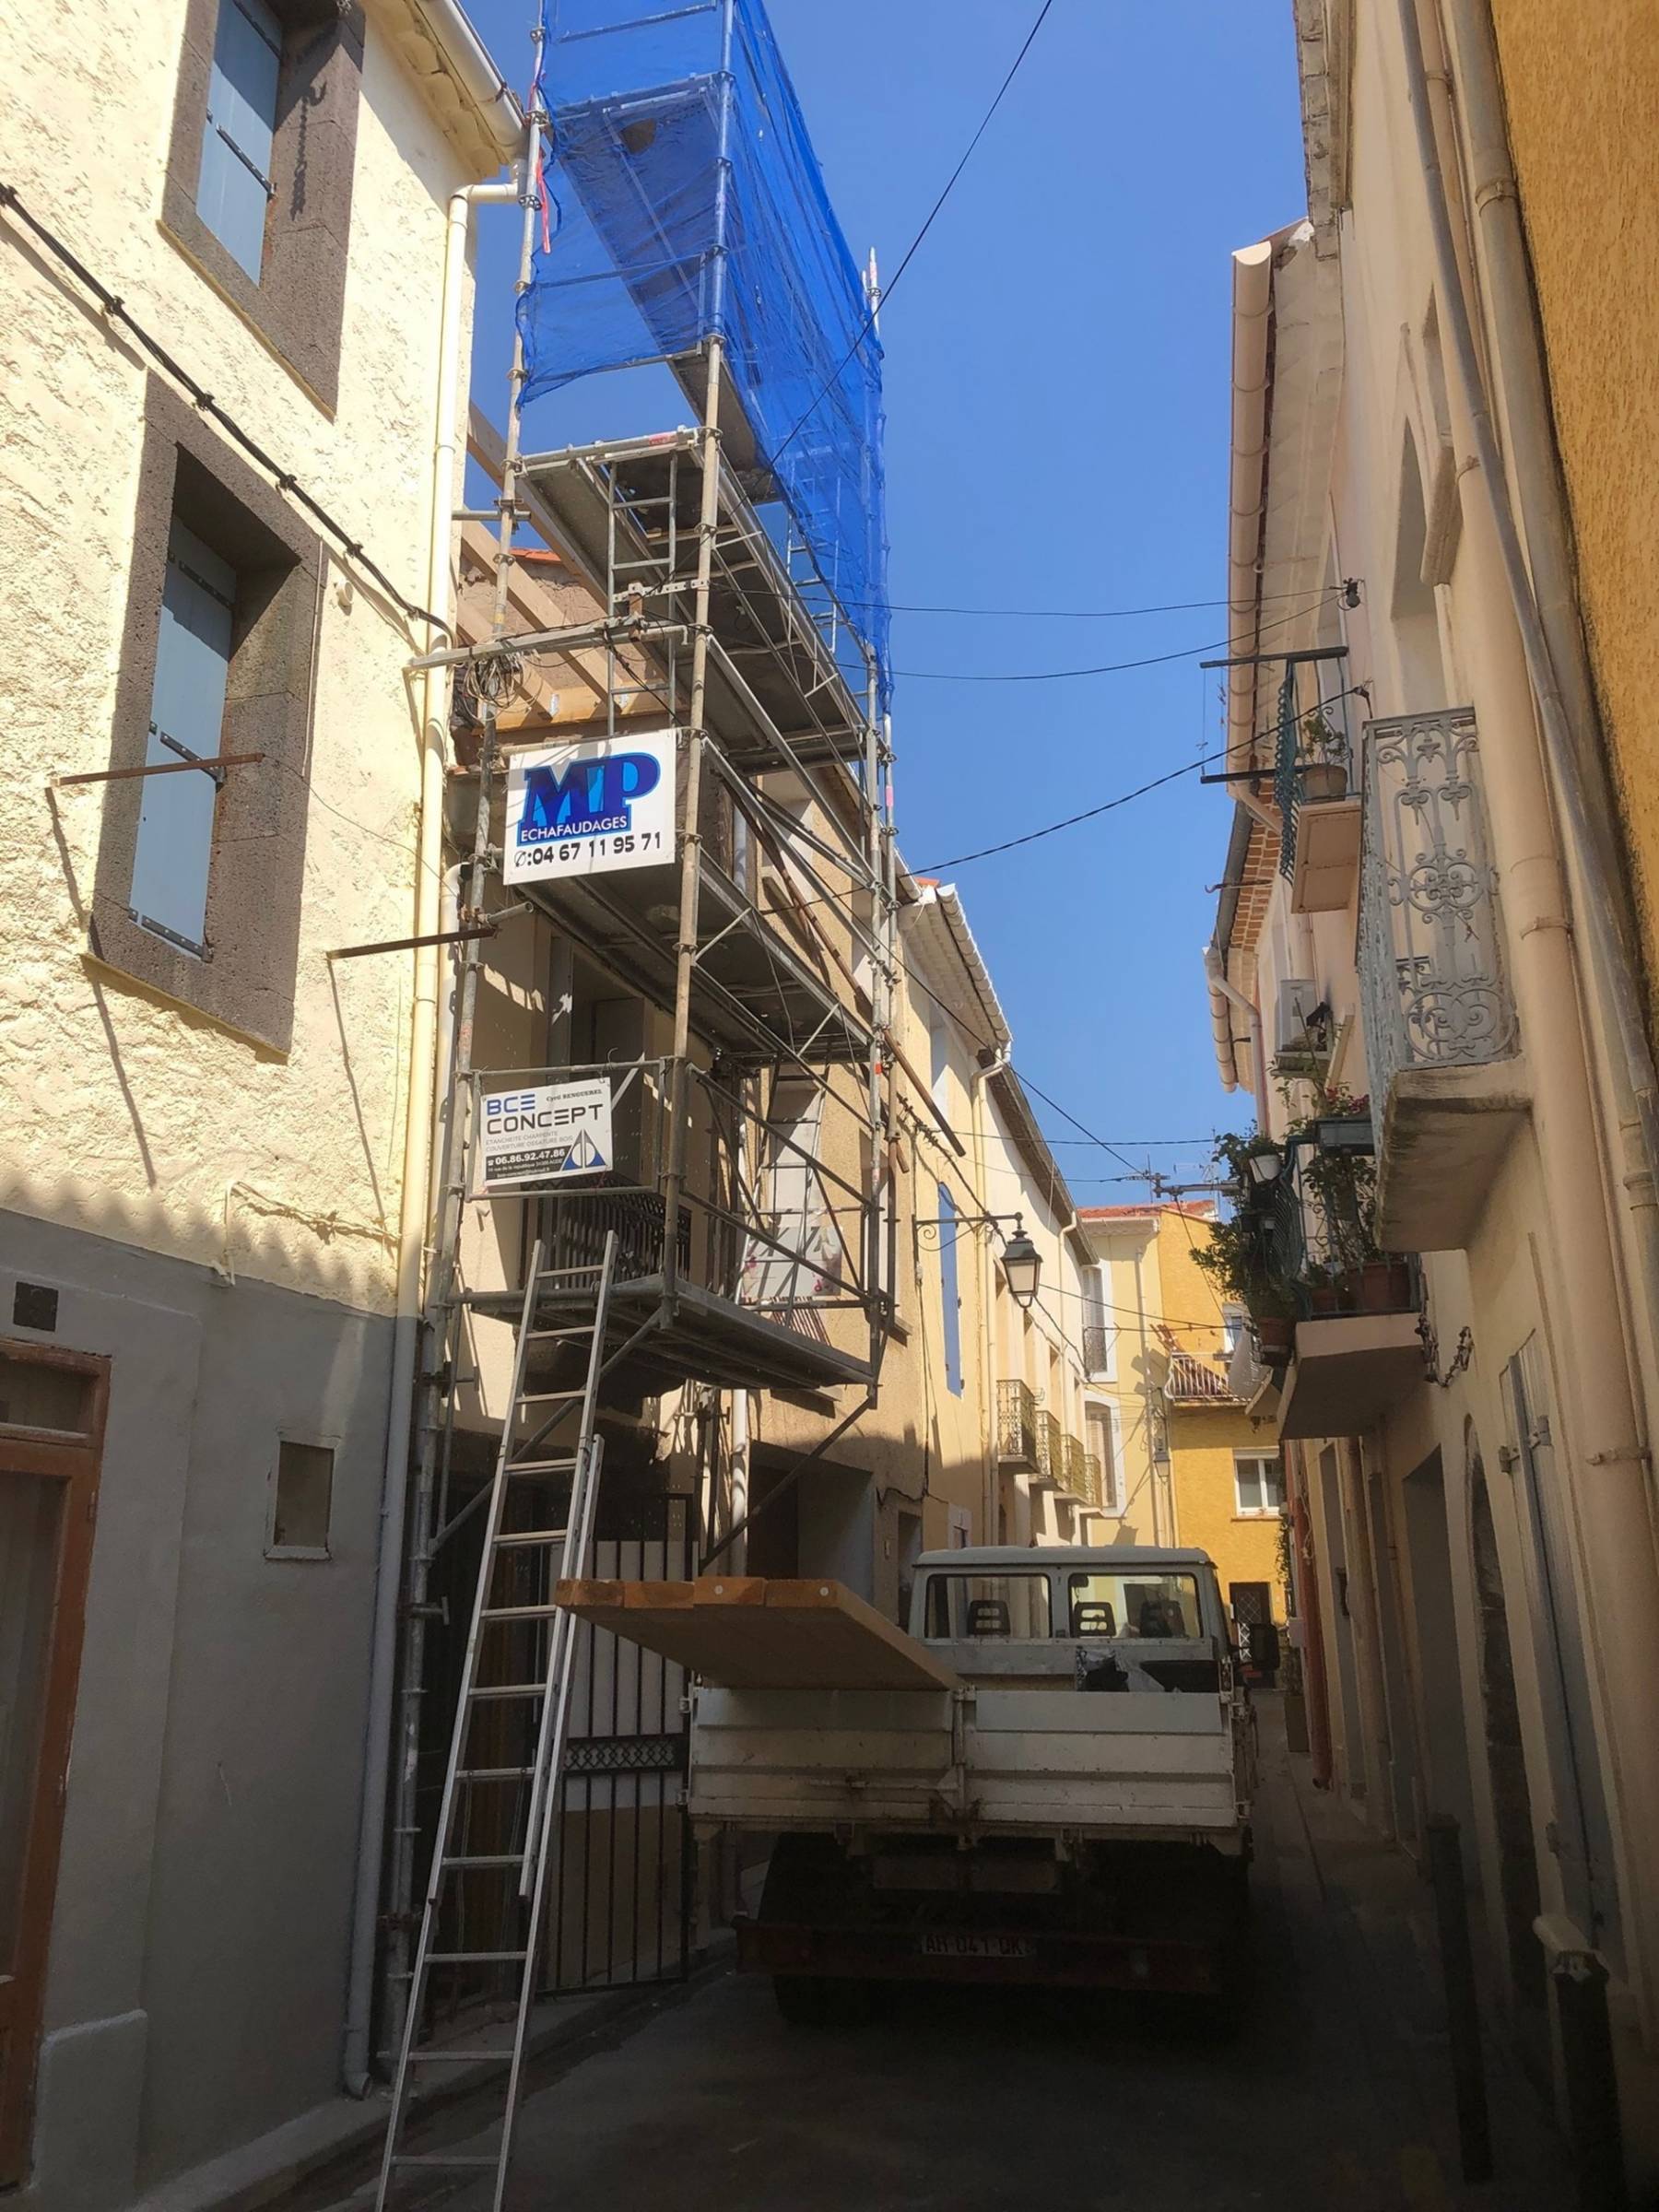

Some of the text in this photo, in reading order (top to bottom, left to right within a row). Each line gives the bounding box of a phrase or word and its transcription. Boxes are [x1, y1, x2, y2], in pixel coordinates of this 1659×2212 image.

[518, 752, 661, 831] MP
[521, 815, 628, 843] ECHAFAUDAGES
[559, 842, 581, 862] 67
[589, 838, 606, 858] 11
[613, 834, 635, 853] 95
[641, 830, 661, 851] 71
[487, 1093, 535, 1116] BCE
[487, 1103, 604, 1135] CONCEPT
[495, 1148, 565, 1165] 06.86.92.47.86
